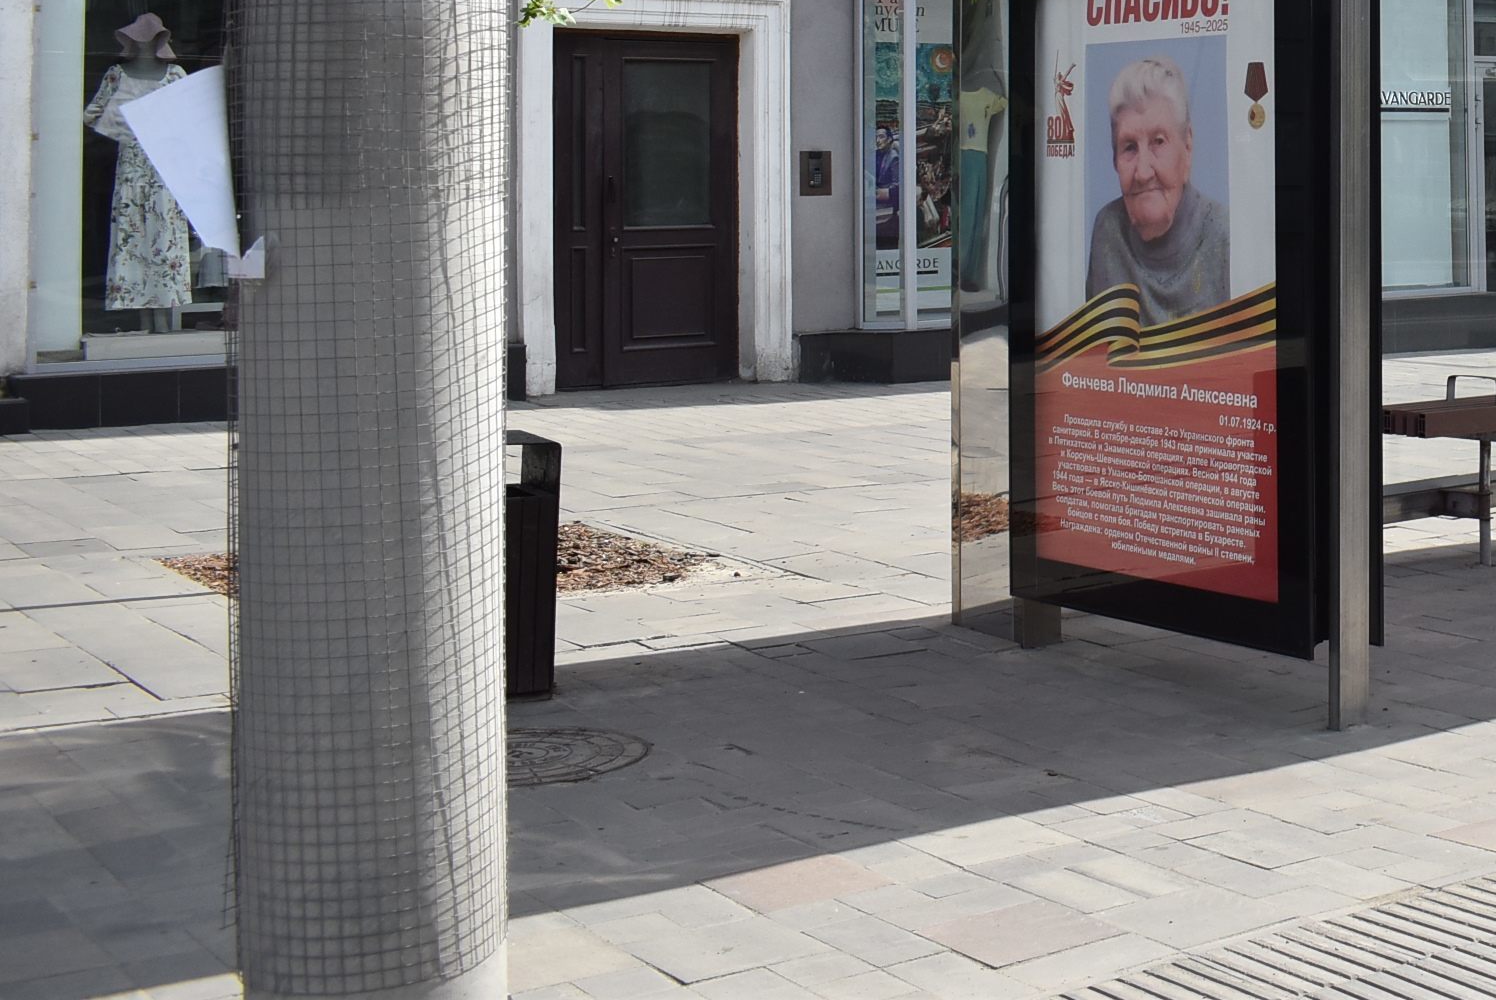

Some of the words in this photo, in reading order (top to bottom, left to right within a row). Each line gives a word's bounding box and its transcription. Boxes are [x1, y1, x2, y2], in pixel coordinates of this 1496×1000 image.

[1380, 91, 1450, 105] VANGARDE
[1047, 116, 1062, 139] 80
[1047, 144, 1075, 159] ПОБЕДА!
[1062, 371, 1114, 392] Фенчева
[1118, 377, 1177, 399] Людмила
[1180, 384, 1257, 408] Алексеевна
[1064, 414, 1101, 427] Проходила
[1103, 419, 1128, 432] службу
[1136, 425, 1164, 435] составе
[1164, 427, 1178, 437] 2-го
[1180, 429, 1224, 444] Украинского
[1226, 435, 1254, 448] фронта
[1219, 415, 1261, 430] 01.07.1924
[1263, 422, 1277, 434] г.р.
[1053, 425, 1092, 438] санитаркой.
[1101, 432, 1158, 448] октябре-декабре
[1161, 439, 1176, 448] 1943
[1177, 443, 1192, 452] года
[1194, 445, 1235, 458] принимала
[1237, 451, 1268, 462] участие
[1054, 436, 1097, 449] Пятихатской
[1104, 442, 1145, 457] Знаменской
[1187, 457, 1208, 467] далее
[1210, 457, 1272, 476] Кировоградской
[1058, 461, 1100, 474] участвовала
[1108, 466, 1184, 488] Уманско-Ботошанской
[1185, 480, 1222, 494] операции,
[1231, 488, 1259, 500] августе
[1066, 449, 1150, 469] Корсунь-Шевченковской
[1152, 463, 1190, 477] операциях.
[1192, 467, 1219, 480] Весной
[1221, 472, 1238, 483] 1944
[1240, 477, 1256, 487] года
[1052, 481, 1068, 492] Весь
[1070, 486, 1084, 495] этот
[1085, 487, 1110, 499] боевой
[1112, 492, 1128, 503] путь
[1130, 494, 1162, 508] Людмила
[1163, 500, 1204, 516] Алексеевна
[1206, 509, 1243, 522] зашивала
[1244, 515, 1266, 527] раны
[1053, 471, 1068, 480] 1944
[1069, 474, 1083, 483] года
[1169, 490, 1225, 507] стратегической
[1226, 500, 1266, 513] операции.
[1056, 495, 1089, 508] солдатам,
[1091, 501, 1124, 513] помогала
[1125, 505, 1157, 519] бригадам
[1159, 512, 1225, 532] транспортировать
[1226, 525, 1260, 538] раненых
[1067, 507, 1093, 519] бойцов
[1100, 514, 1116, 524] поля
[1118, 516, 1132, 527] боя.
[1134, 518, 1160, 534] Победу
[1160, 525, 1196, 539] встретила
[1204, 531, 1246, 548] Бухаресте.
[1060, 518, 1103, 534] Награждена:
[1104, 528, 1134, 540] орденом
[1135, 532, 1187, 550] Отечественной
[1189, 543, 1213, 556] войны
[1221, 550, 1255, 565] степени,
[1111, 540, 1157, 556] юбилейными
[1159, 550, 1197, 564] медалями.
